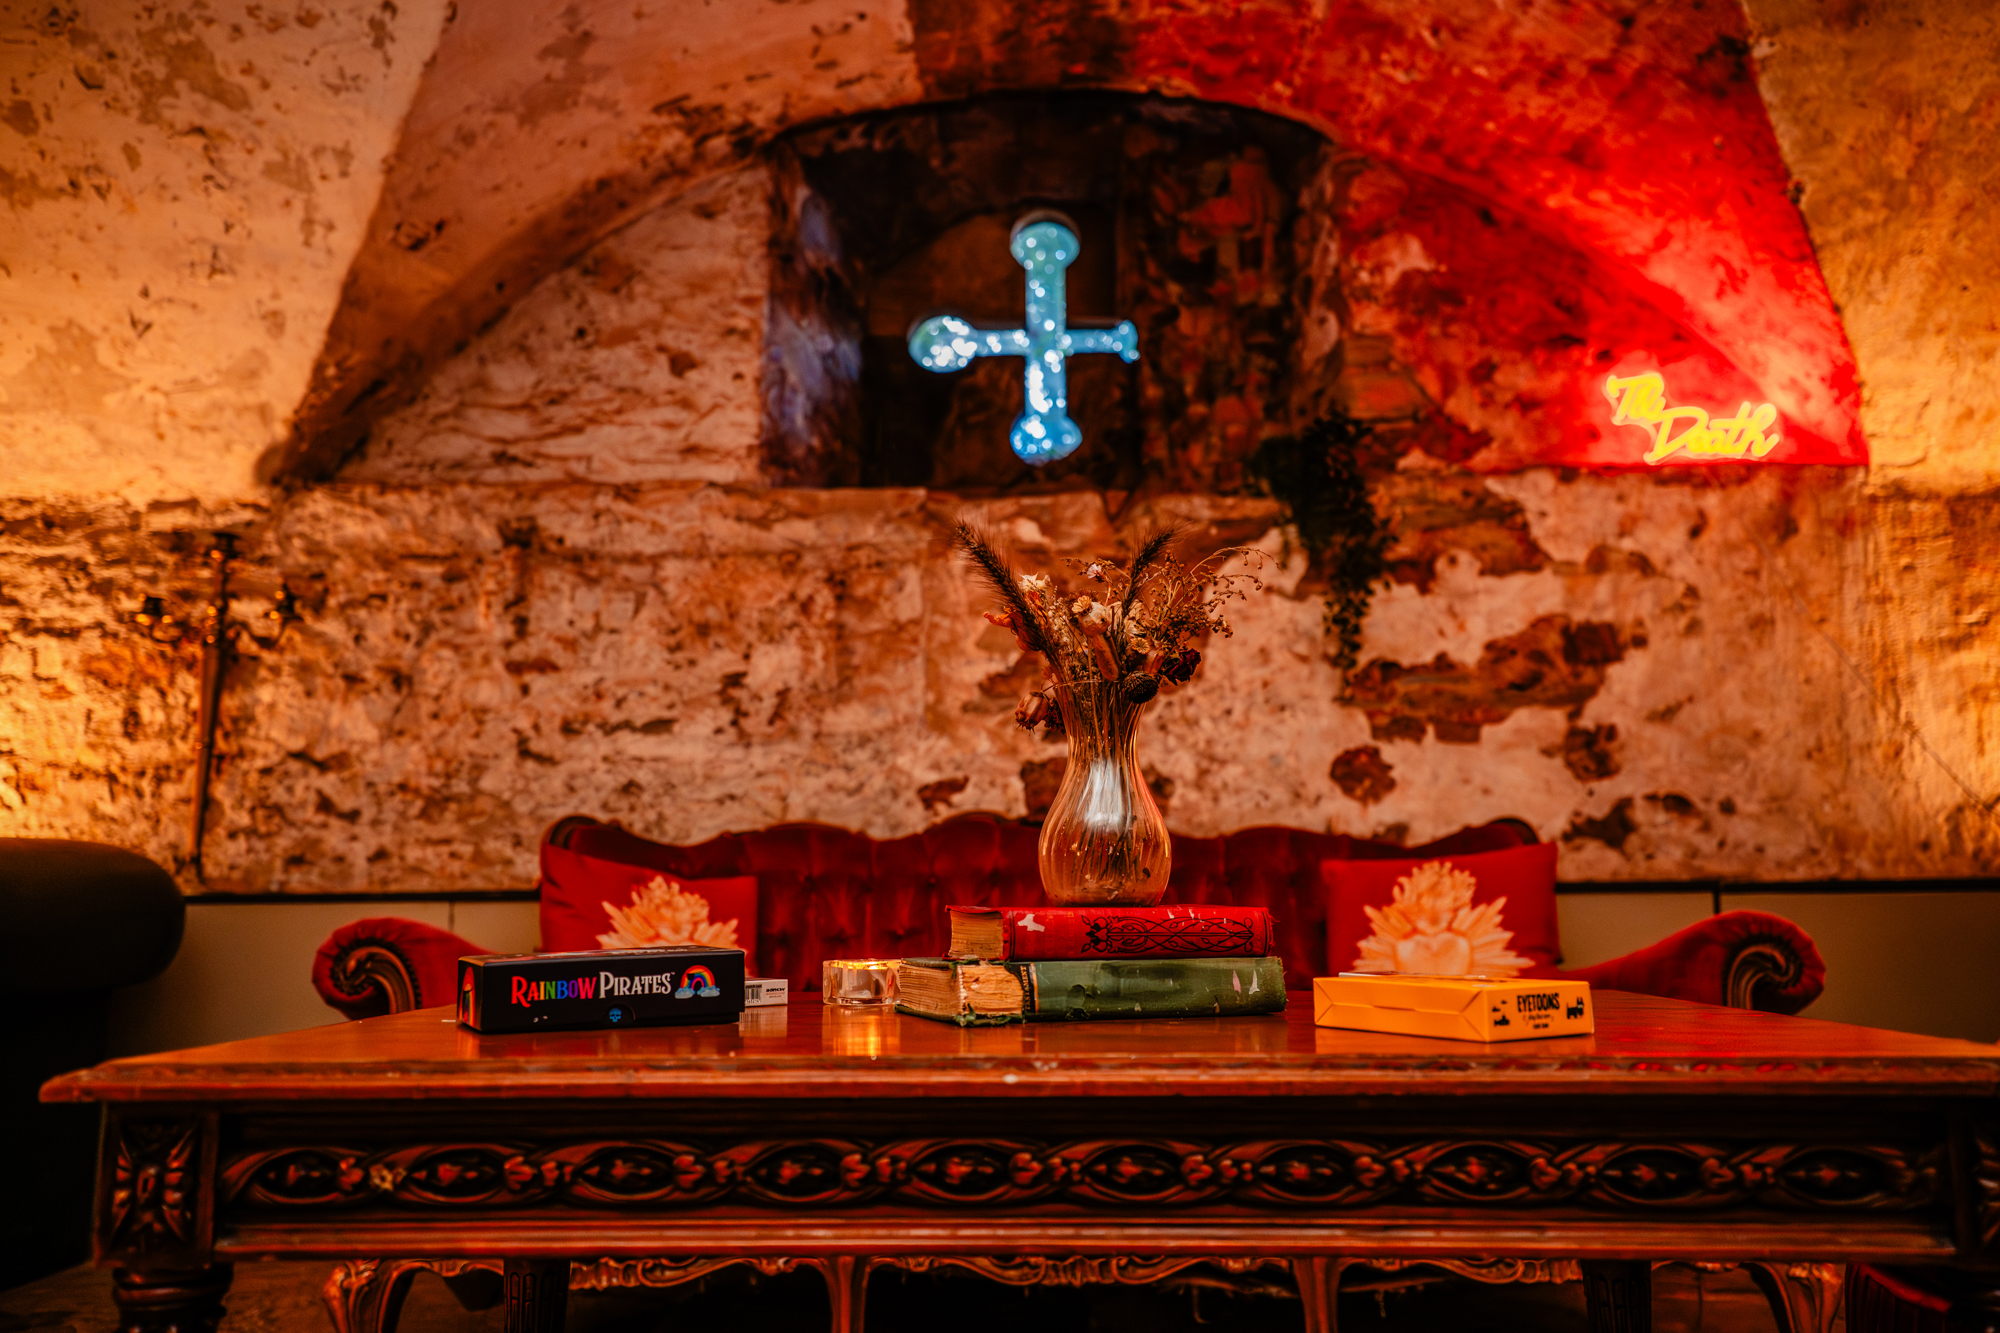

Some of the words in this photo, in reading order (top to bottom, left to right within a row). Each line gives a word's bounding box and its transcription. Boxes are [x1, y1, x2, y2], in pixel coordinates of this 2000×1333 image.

[1606, 372, 1667, 426] The
[1643, 401, 1780, 465] Death
[511, 975, 597, 1008] RAINBOW
[1517, 992, 1560, 1013] EYETOONS
